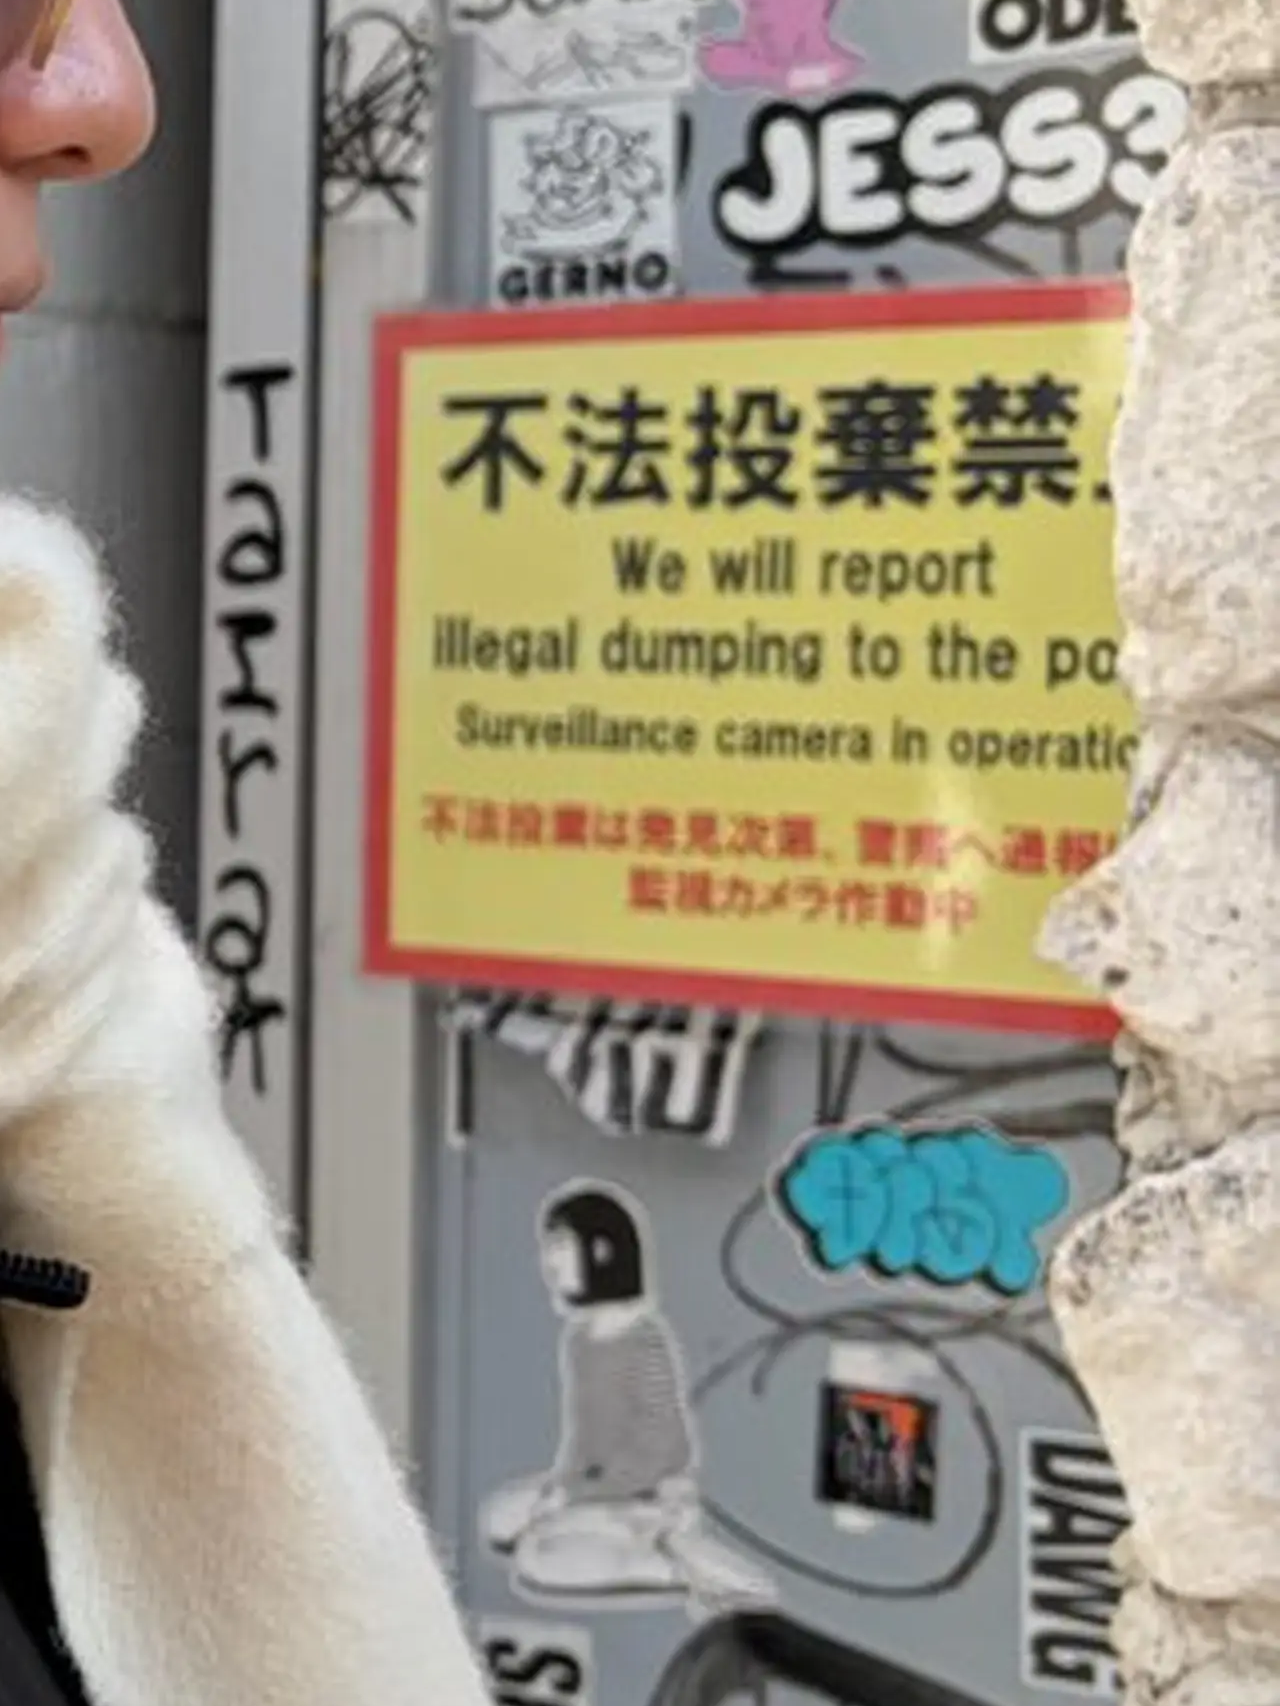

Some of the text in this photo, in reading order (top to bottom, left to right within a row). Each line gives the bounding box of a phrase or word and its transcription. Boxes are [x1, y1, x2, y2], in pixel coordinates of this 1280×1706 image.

[443, 377, 1113, 513] 不法投棄禁
[612, 537, 994, 603] We will report
[600, 617, 822, 684] dumping
[849, 623, 901, 680] to
[929, 621, 1019, 681] the
[455, 702, 700, 755] Surveillance
[714, 719, 872, 761] camera
[892, 717, 930, 763] in
